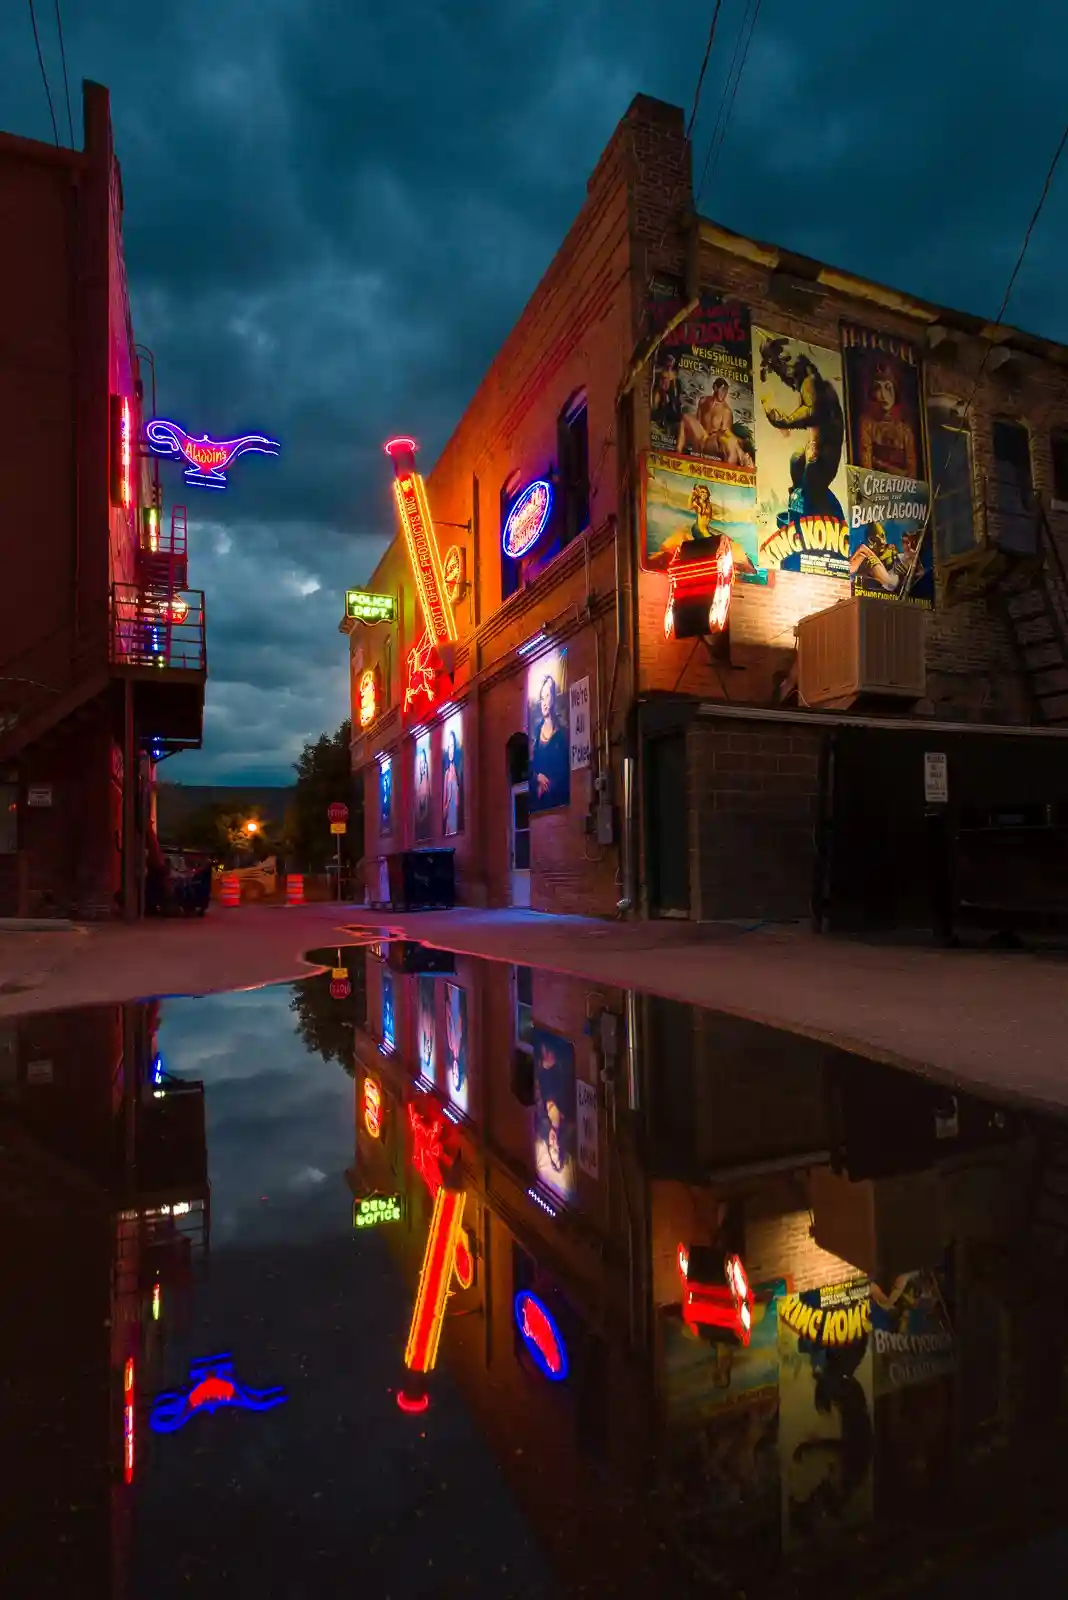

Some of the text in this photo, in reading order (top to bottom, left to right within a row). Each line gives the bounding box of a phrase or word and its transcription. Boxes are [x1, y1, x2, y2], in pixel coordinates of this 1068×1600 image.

[678, 357, 749, 384] JOYCE SHEFFIELD
[185, 442, 227, 464] Aladdin's
[863, 474, 918, 496] CREATURE
[851, 501, 927, 528] BLACK LAGOON
[799, 515, 850, 559] KONG
[404, 496, 447, 636] SCOTT OFFICE PRODUCTS INC
[349, 593, 393, 609] POLICE
